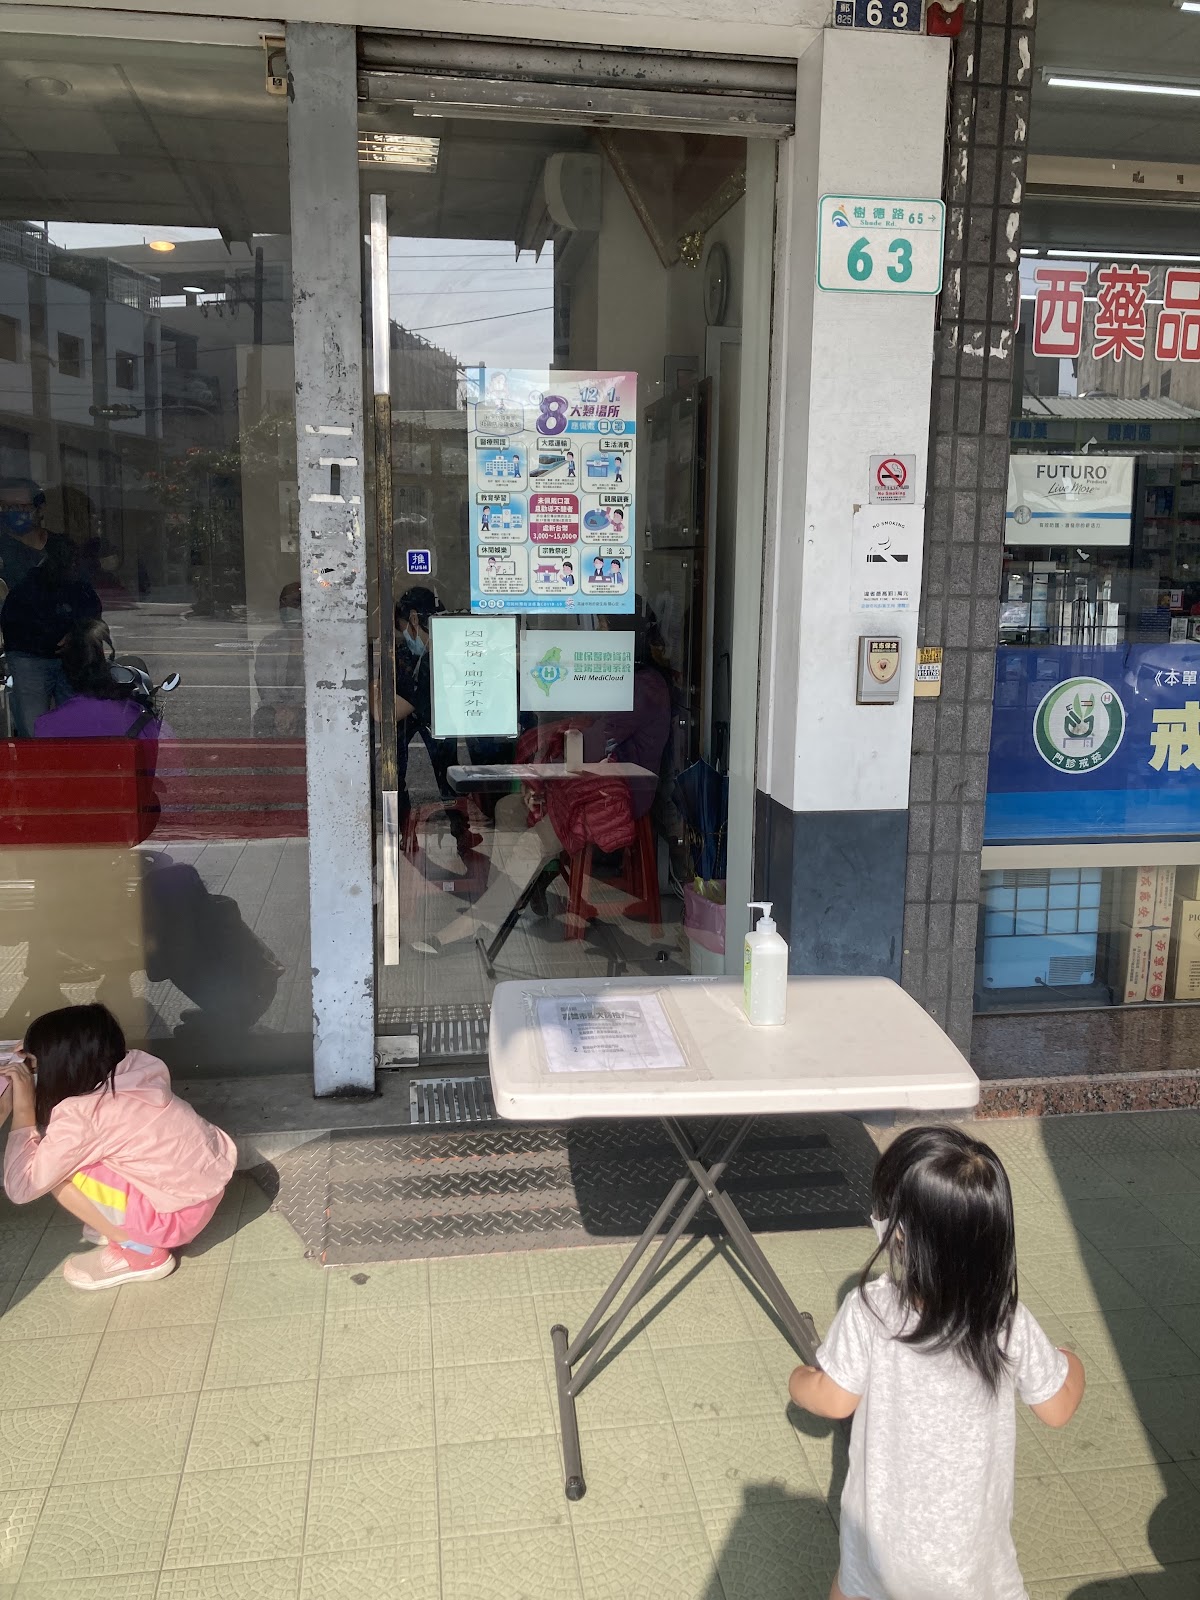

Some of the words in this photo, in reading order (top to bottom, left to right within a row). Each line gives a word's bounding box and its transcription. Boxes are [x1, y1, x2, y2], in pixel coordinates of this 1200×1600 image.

[837, 15, 852, 24] 825
[866, 0, 909, 27] 63
[853, 206, 905, 220] 樹德路
[908, 213, 924, 225] 65
[847, 236, 913, 283] 63
[536, 395, 569, 435] 8
[569, 404, 621, 418] 大類場所
[541, 439, 568, 447] 大眾運輸
[604, 441, 630, 449] 生活消費
[1036, 464, 1108, 480] FUTURO
[1047, 482, 1070, 494] Live
[1071, 481, 1096, 494] More
[481, 494, 507, 502] 教育學習
[881, 520, 906, 529] SMOKING
[542, 547, 568, 555] 宗教祭祀
[411, 553, 426, 565] 推
[574, 651, 631, 662] 健保醫療資訊
[1051, 751, 1103, 769] 門診戒菸
